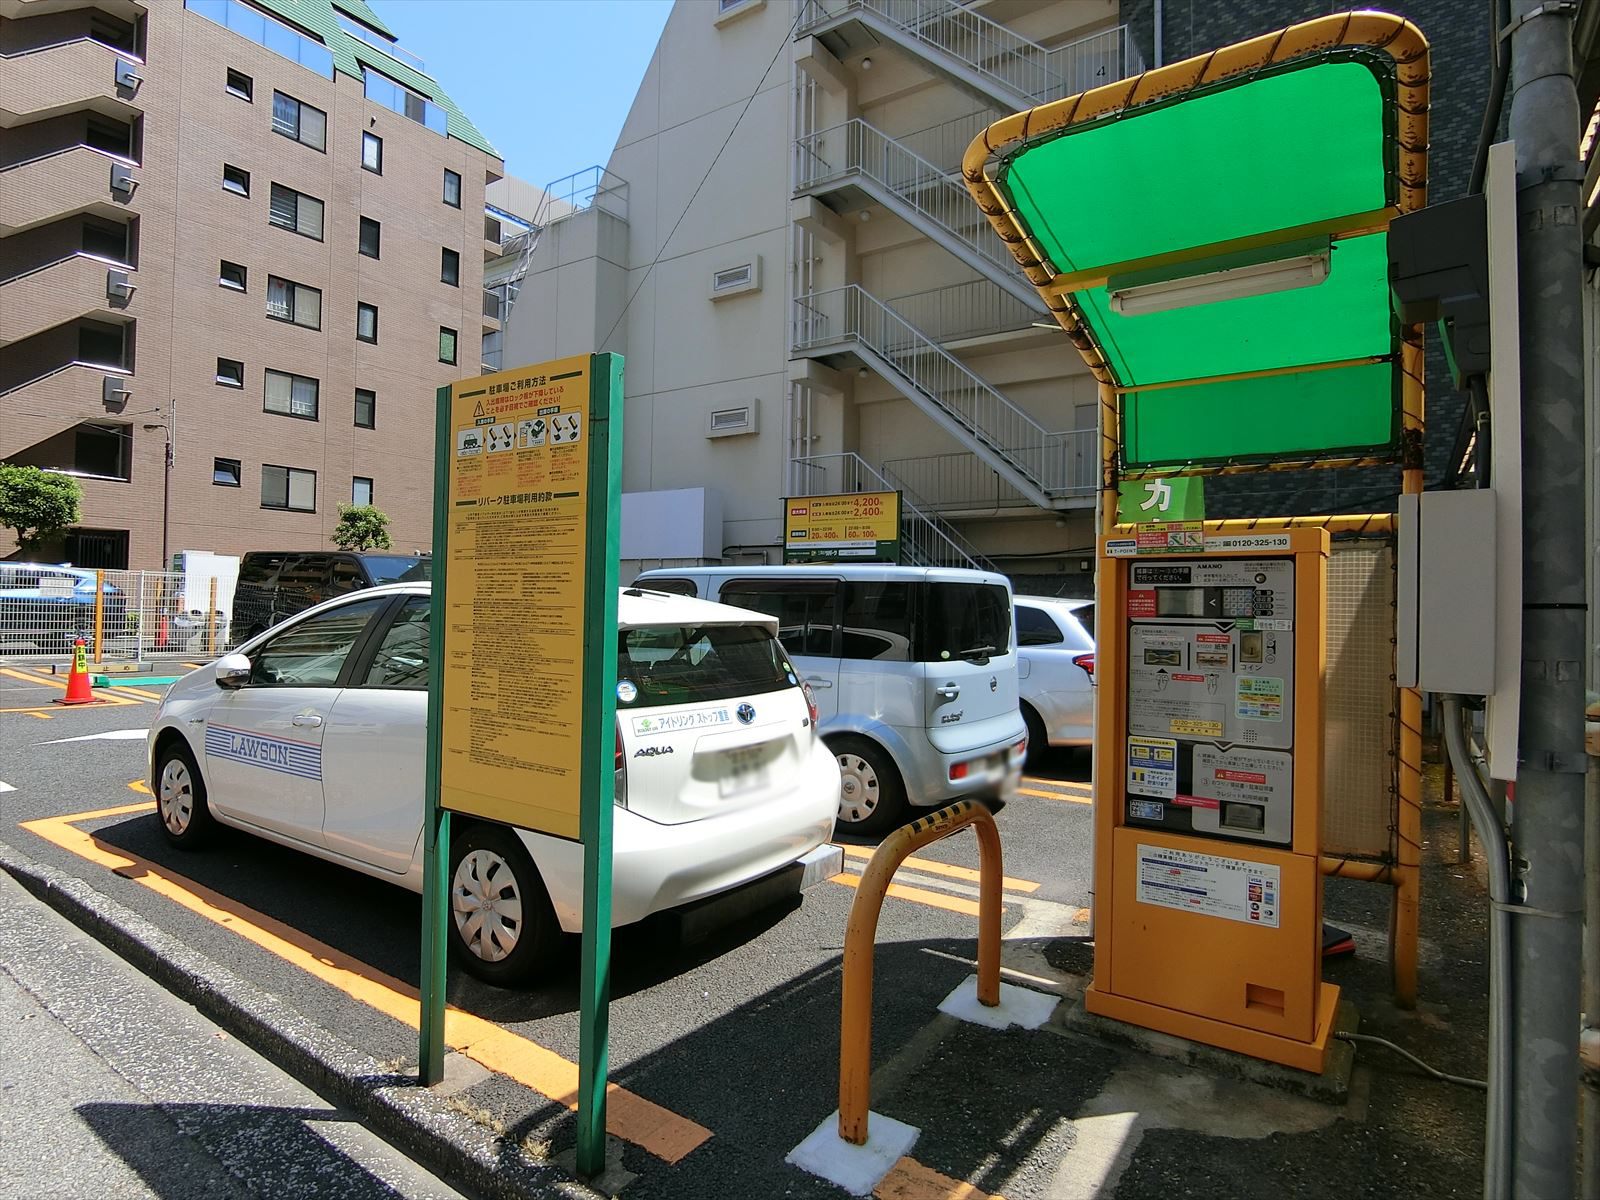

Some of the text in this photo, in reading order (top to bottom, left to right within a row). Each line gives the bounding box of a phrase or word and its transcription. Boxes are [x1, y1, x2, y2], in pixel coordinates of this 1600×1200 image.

[489, 375, 547, 395] 駐車場ご利用方法
[478, 491, 553, 507] リパーク駐車場利用約款
[1232, 538, 1288, 547] 0120-325-130
[658, 714, 695, 729] アイドリング
[230, 735, 289, 766] LAWSON
[634, 745, 674, 758] AQUA
